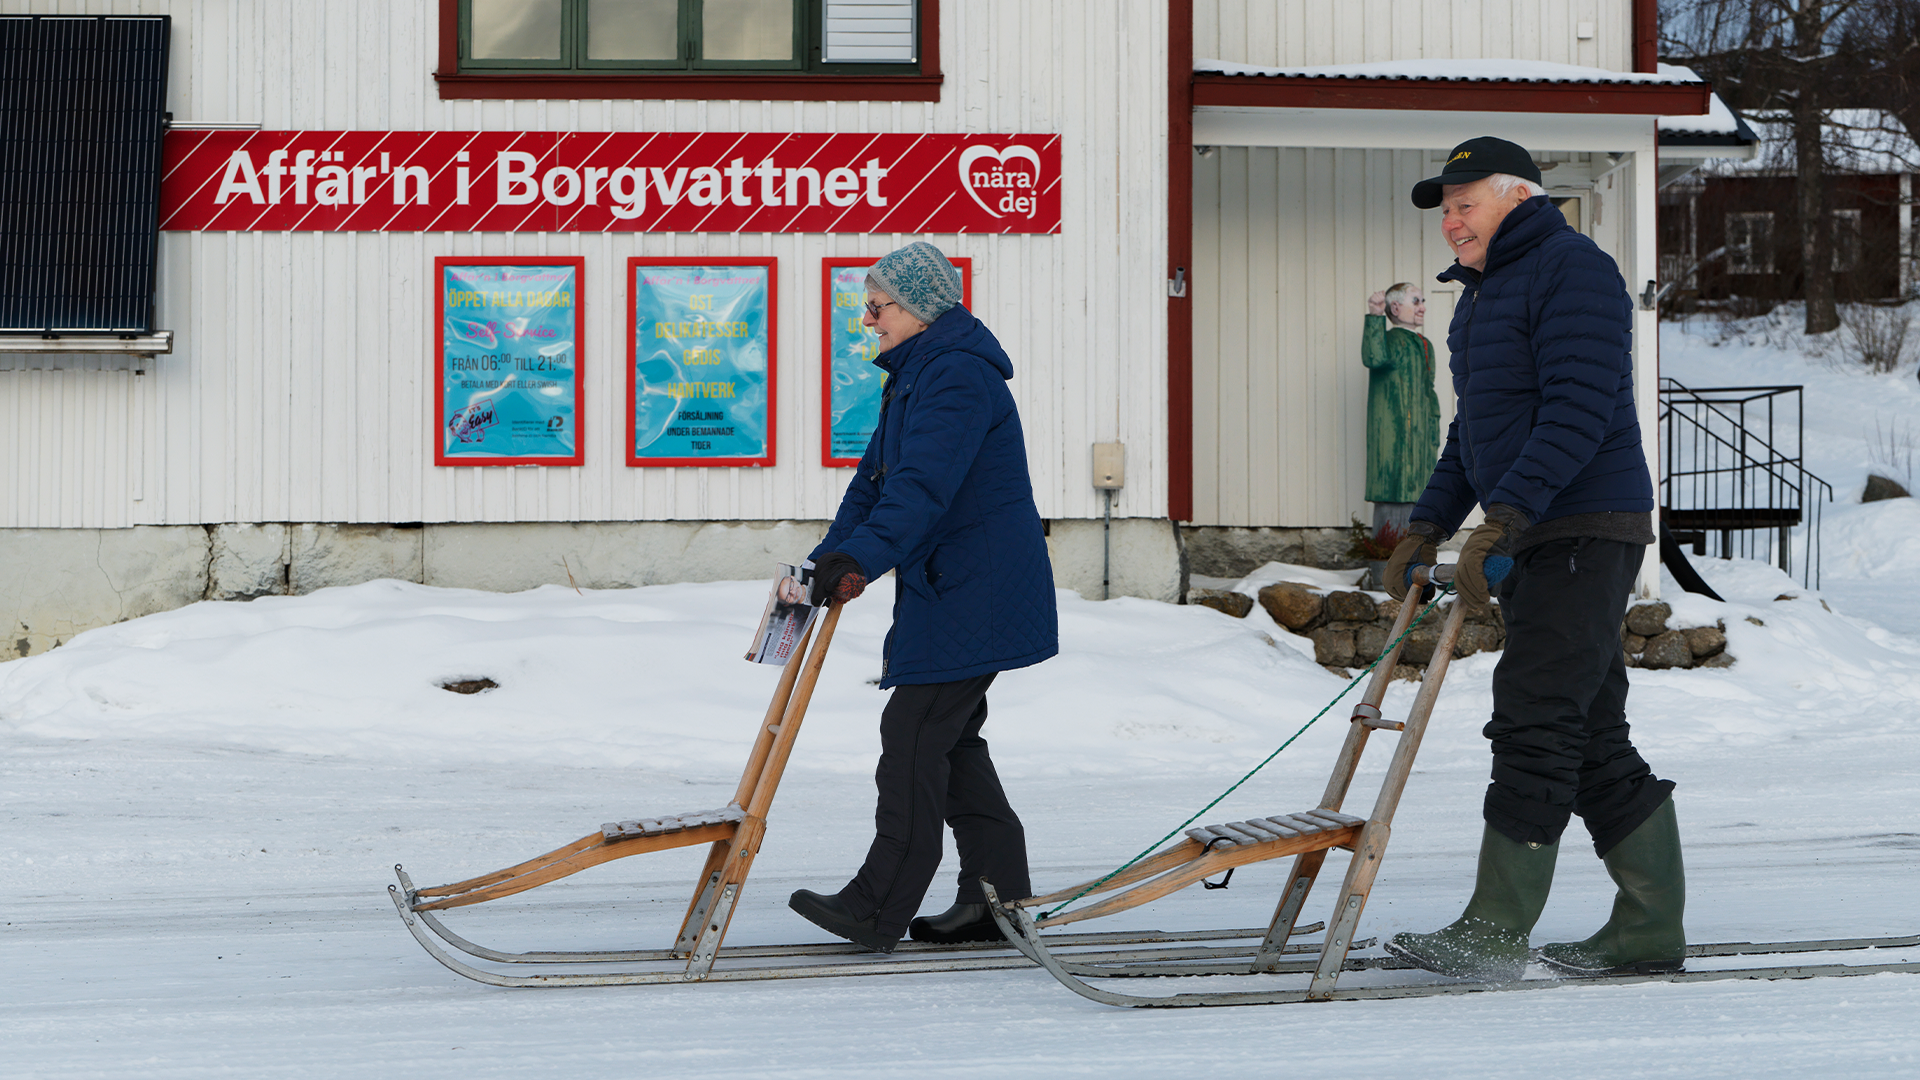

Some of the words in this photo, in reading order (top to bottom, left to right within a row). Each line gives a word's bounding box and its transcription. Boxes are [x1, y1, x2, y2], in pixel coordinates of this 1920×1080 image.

[213, 150, 430, 205] Affär'n
[456, 151, 470, 205] i
[496, 151, 888, 220] Borgvattnet
[972, 166, 1031, 188] nära
[999, 190, 1037, 219] dej
[494, 272, 498, 282] i
[501, 272, 568, 284] Borgvattnet
[643, 276, 682, 286] Affär'n
[687, 276, 690, 285] i
[693, 276, 760, 288] Borgvattnet
[449, 288, 489, 308] ÖPPET
[491, 291, 524, 308] ALLA
[526, 291, 570, 308] DAGAR
[689, 294, 714, 310] OST
[836, 292, 858, 307] BED
[503, 322, 557, 339] Service
[655, 322, 748, 338] DELIKATESSER
[452, 355, 478, 371] FRÅN
[514, 358, 535, 371] TILL
[683, 348, 721, 366] GODIS
[461, 380, 484, 389] BETALA
[486, 380, 499, 389] MED
[500, 380, 516, 389] KORT
[518, 380, 536, 389] ELLER
[537, 380, 558, 389] SWISH
[668, 382, 736, 398] HANTVERK
[678, 410, 724, 420] FÖRSÄLJNING
[666, 427, 690, 436] UNDER
[692, 426, 735, 436] BEMANNADE
[690, 440, 712, 450] TIDER
